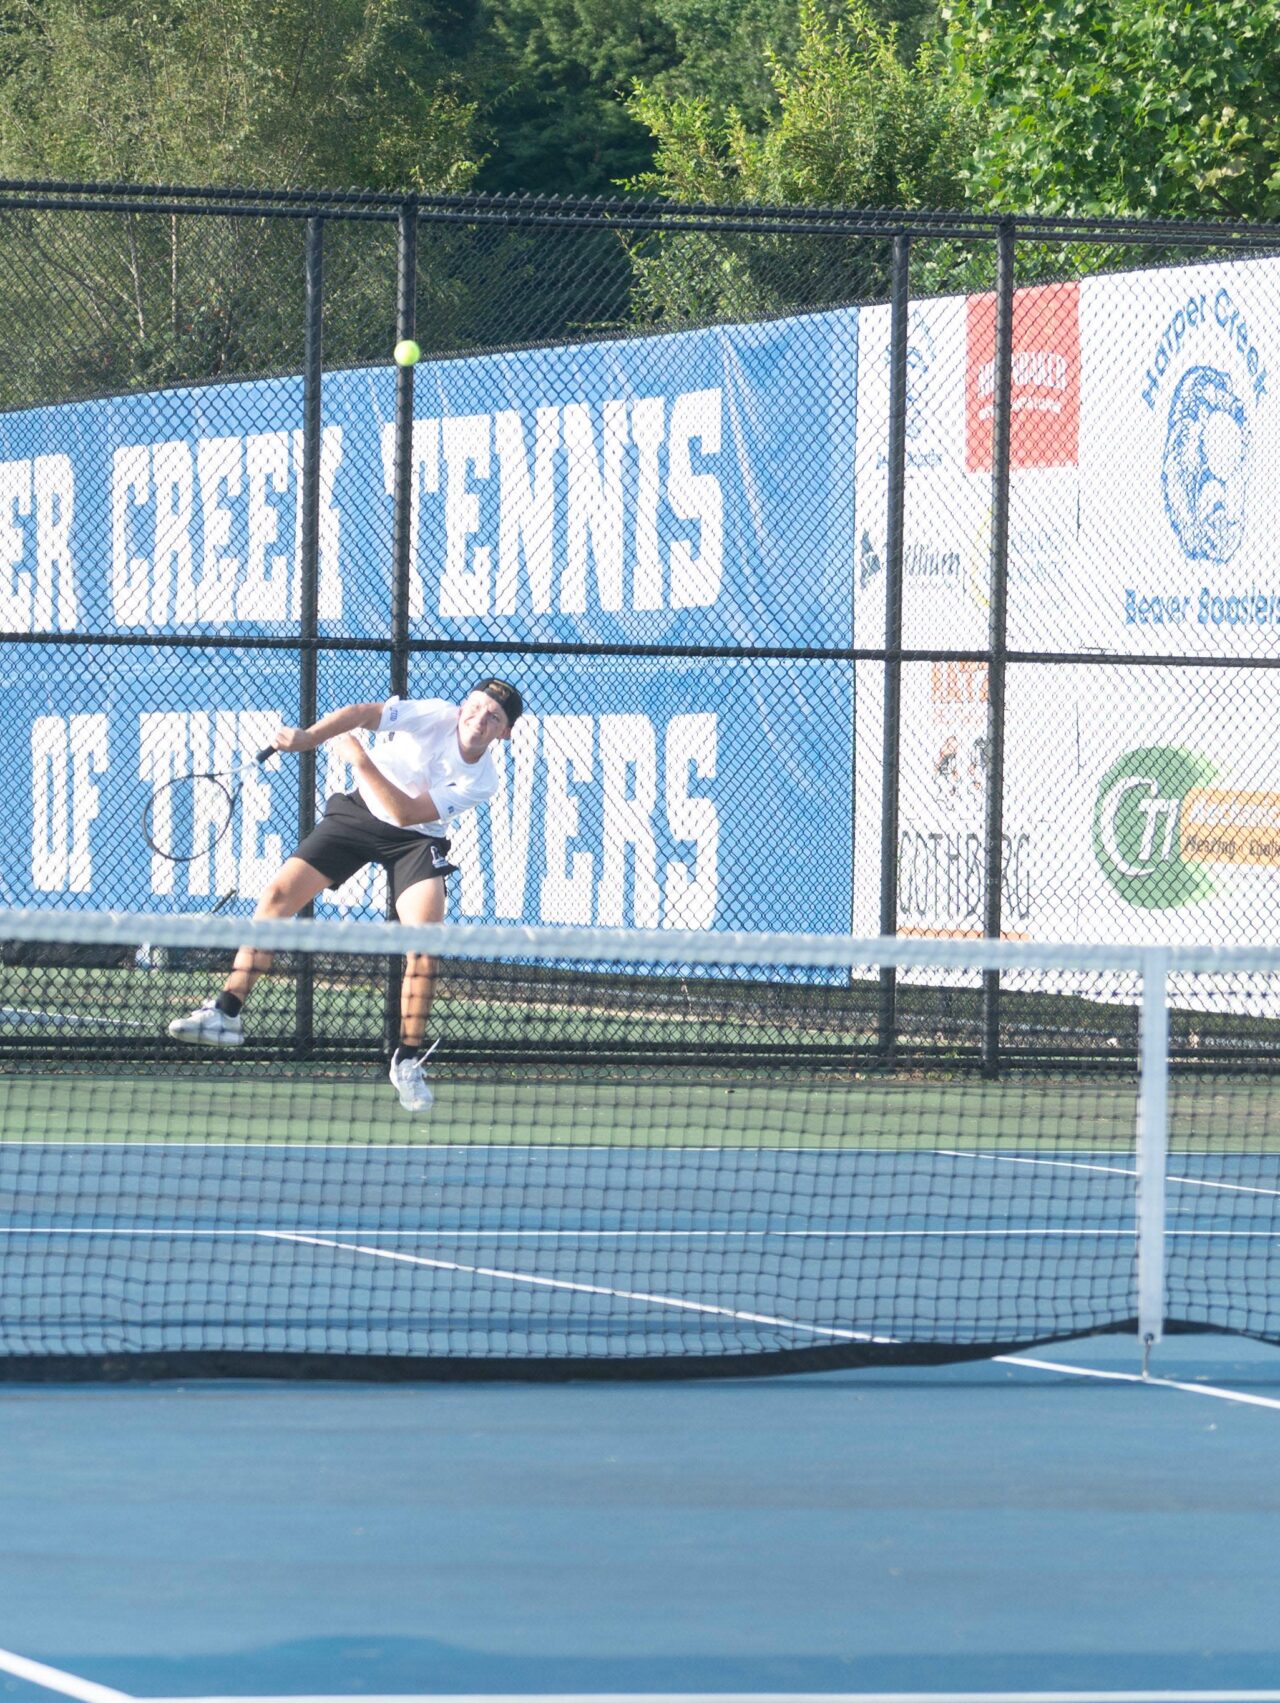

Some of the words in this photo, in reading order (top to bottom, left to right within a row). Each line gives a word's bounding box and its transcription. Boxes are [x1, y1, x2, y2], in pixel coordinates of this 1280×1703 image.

[1142, 294, 1207, 411] Harper
[1215, 287, 1268, 407] Creek
[111, 425, 343, 626] CREEK
[380, 387, 724, 618] TENNIS
[1125, 588, 1192, 625] Beaver
[31, 713, 109, 893] OF
[138, 710, 282, 899] THE
[898, 830, 1030, 920] GOTHBRG
